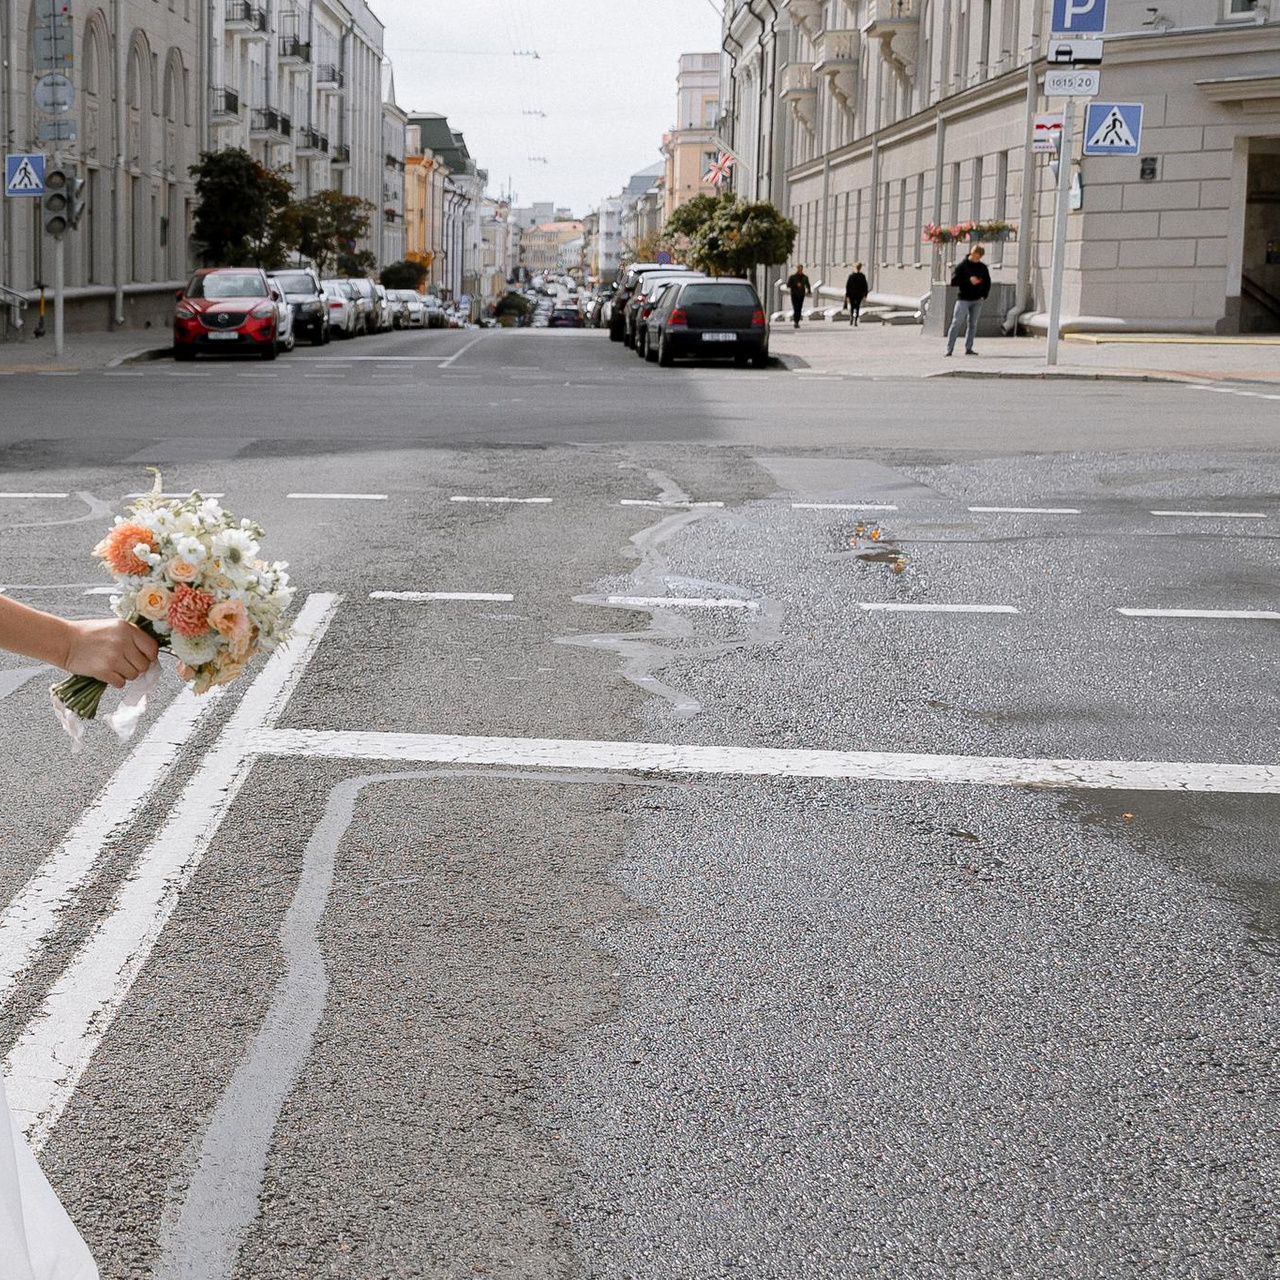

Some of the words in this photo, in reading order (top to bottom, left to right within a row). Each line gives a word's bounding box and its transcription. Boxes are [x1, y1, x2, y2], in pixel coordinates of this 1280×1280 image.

[1052, 79, 1061, 87] 10
[1063, 78, 1073, 88] 15
[1077, 78, 1091, 88] 20
